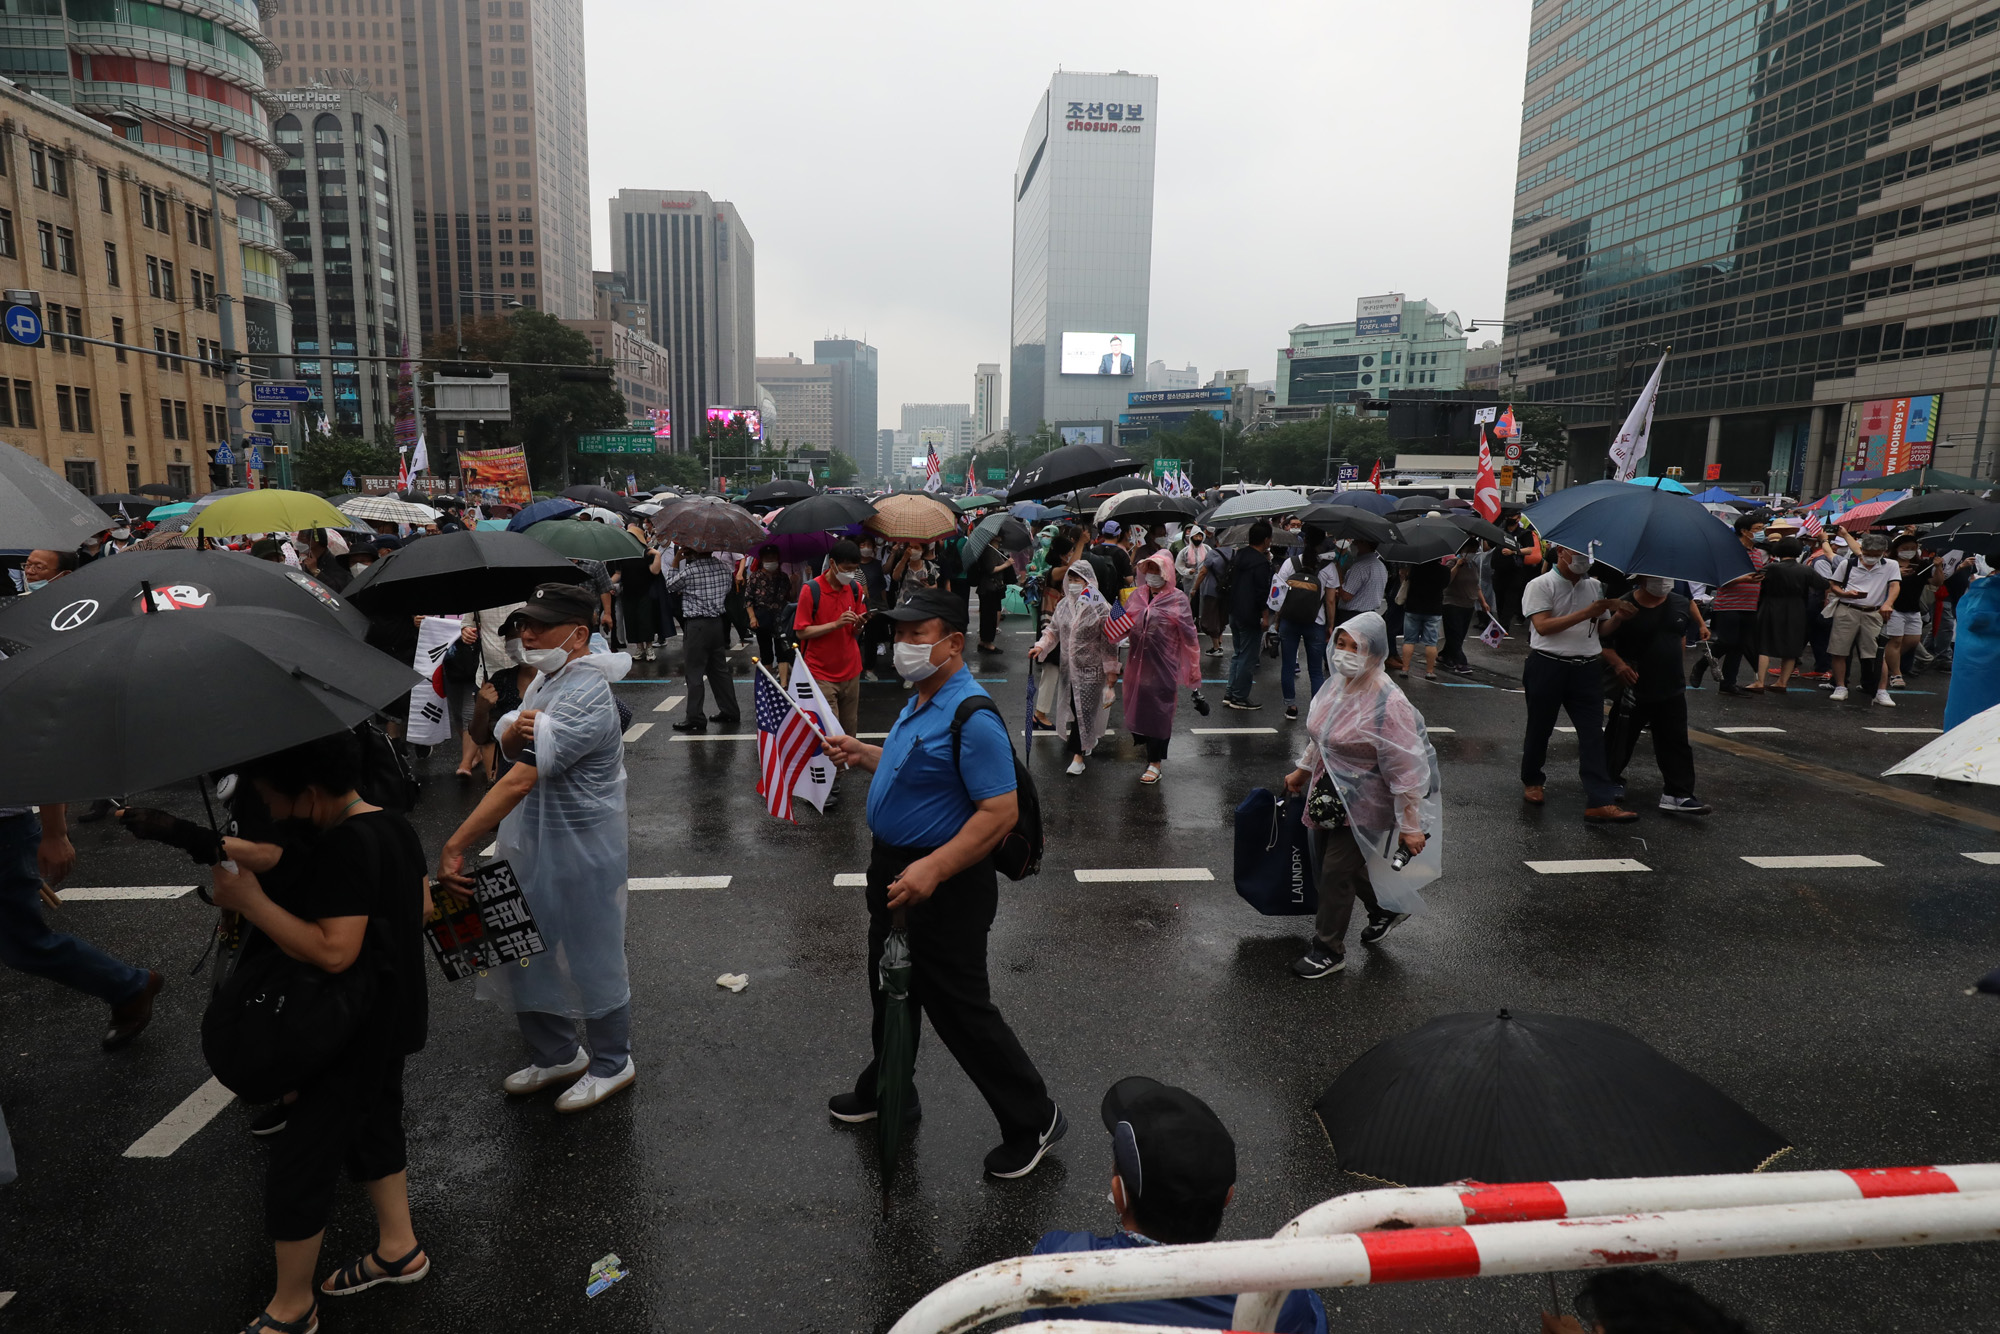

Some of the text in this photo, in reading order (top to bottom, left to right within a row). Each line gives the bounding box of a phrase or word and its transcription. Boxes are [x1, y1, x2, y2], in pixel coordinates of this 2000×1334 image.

[305, 91, 341, 102] Place
[288, 102, 341, 110] 프리미어플레이스
[1065, 102, 1145, 120] 조선일보
[1066, 119, 1141, 133] chosun.com
[257, 387, 286, 395] 새문안로
[1139, 393, 1165, 402] 신한은행
[1889, 400, 1906, 455] K-FASHION
[1508, 447, 1519, 457] 50
[1910, 453, 1930, 462] 2020
[365, 479, 390, 490] 정책으로
[1291, 845, 1304, 903] LAUNDRY
[482, 896, 531, 930] 개표는
[496, 928, 545, 960] 투표는
[1321, 957, 1333, 967] N
